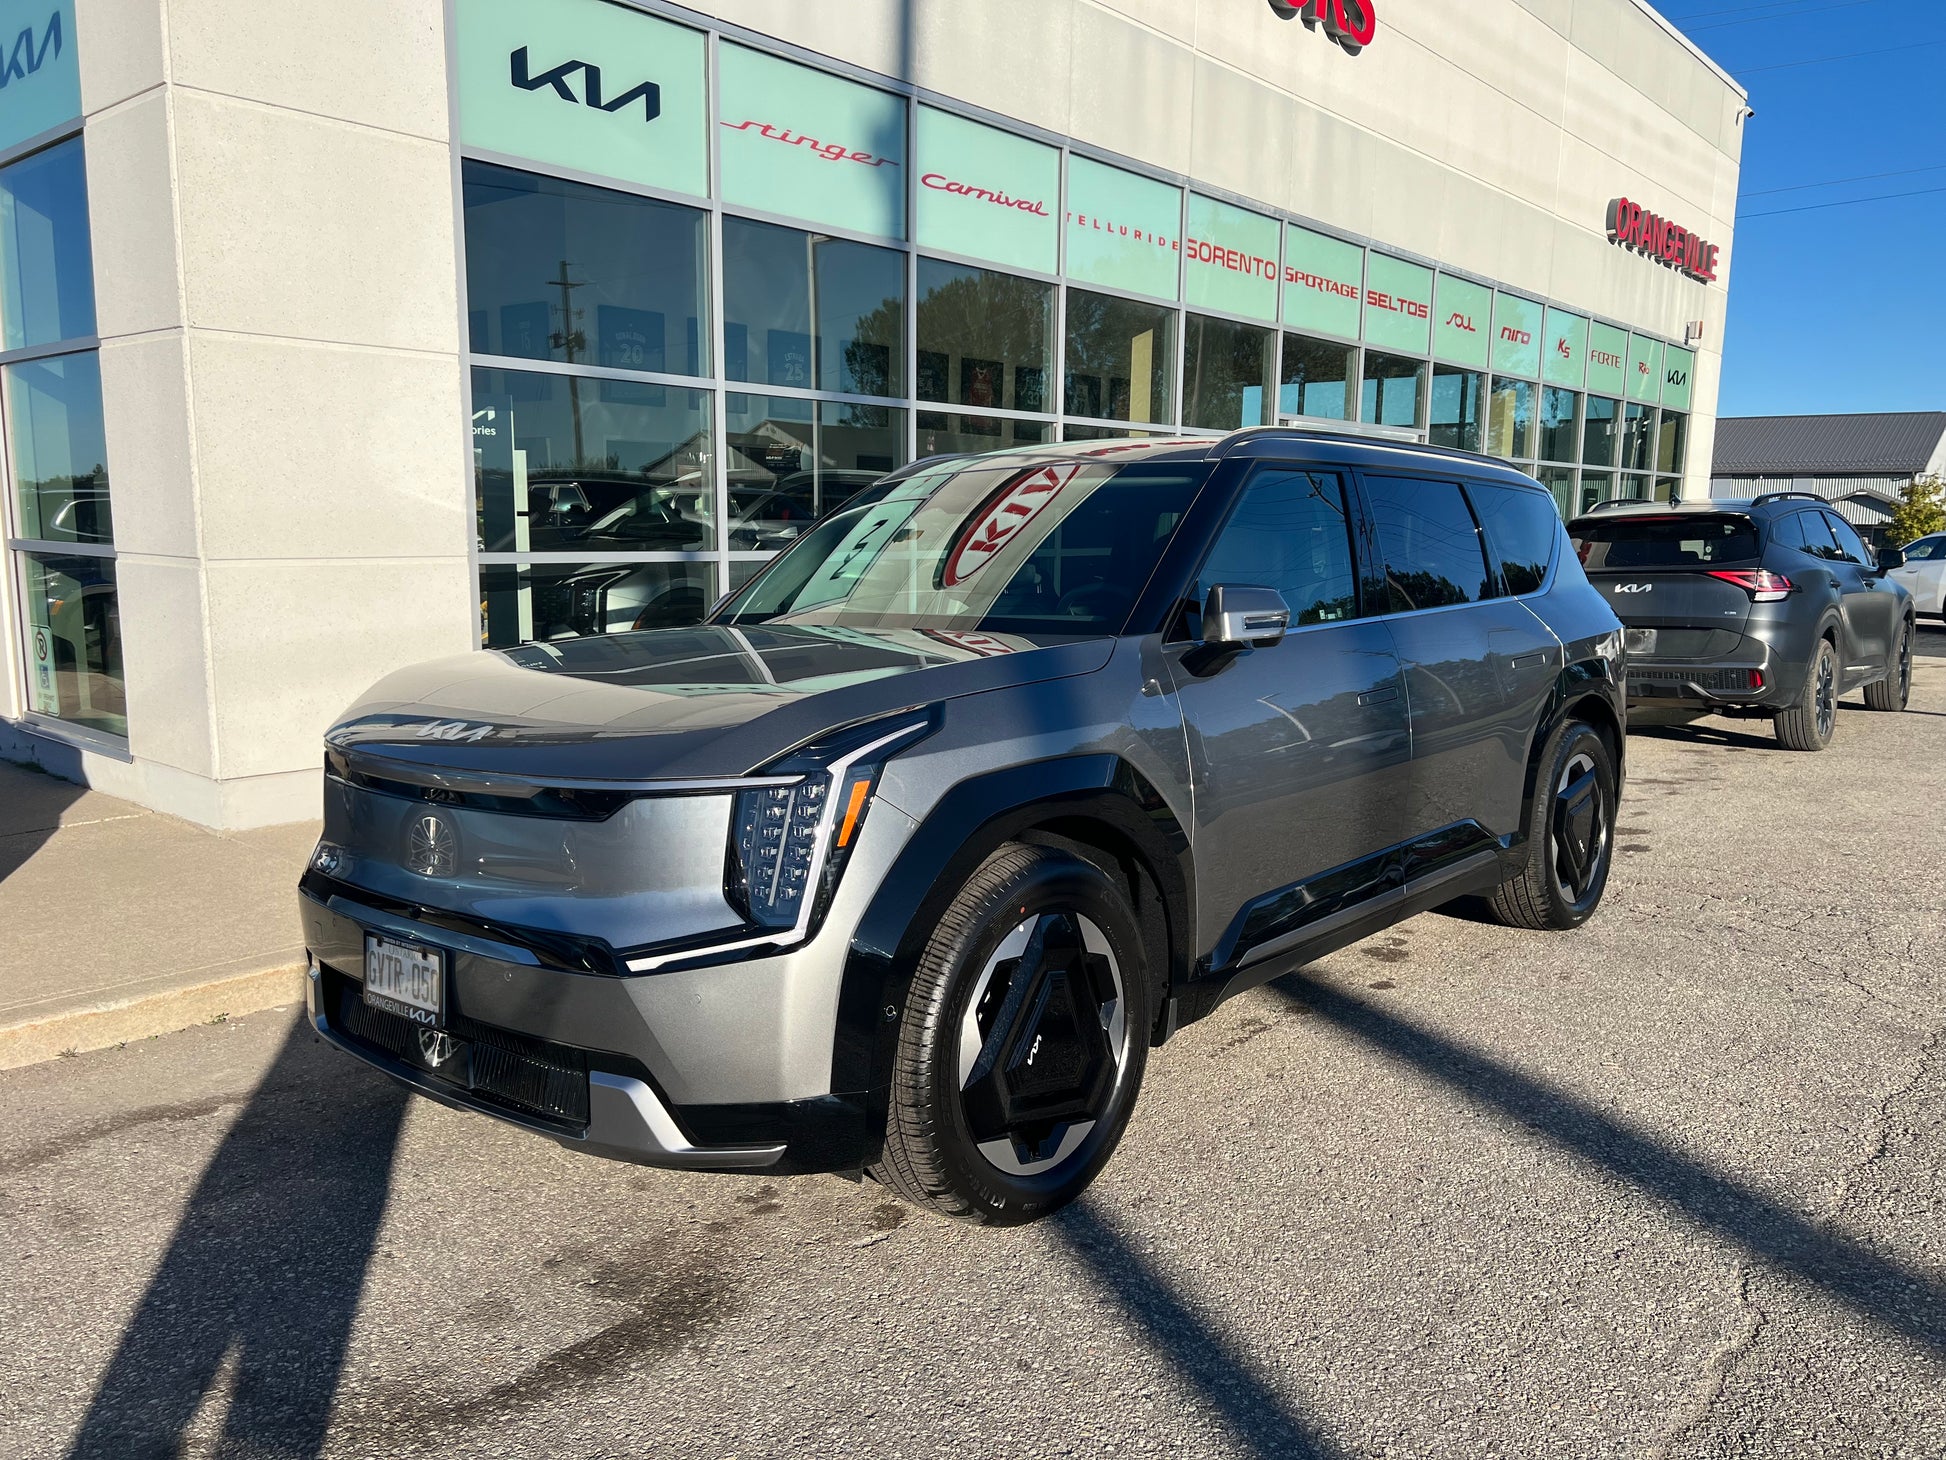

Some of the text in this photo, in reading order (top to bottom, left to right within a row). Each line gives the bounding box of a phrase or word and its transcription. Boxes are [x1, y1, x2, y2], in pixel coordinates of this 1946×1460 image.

[510, 45, 661, 123] KIA
[720, 120, 899, 167] stinger
[921, 173, 1049, 217] Carnival
[1067, 212, 1179, 251] TELLURIDE
[1606, 197, 1719, 282] ORANGEVILLE
[1187, 238, 1276, 281] SORENTO
[1285, 266, 1359, 299] SPORTAGE
[1367, 290, 1428, 319] SELTOS
[1591, 349, 1621, 369] FORTE
[1667, 369, 1686, 386] KIA
[1614, 584, 1653, 593] KIA
[367, 993, 436, 1026] ORANGEVILLE KIA
